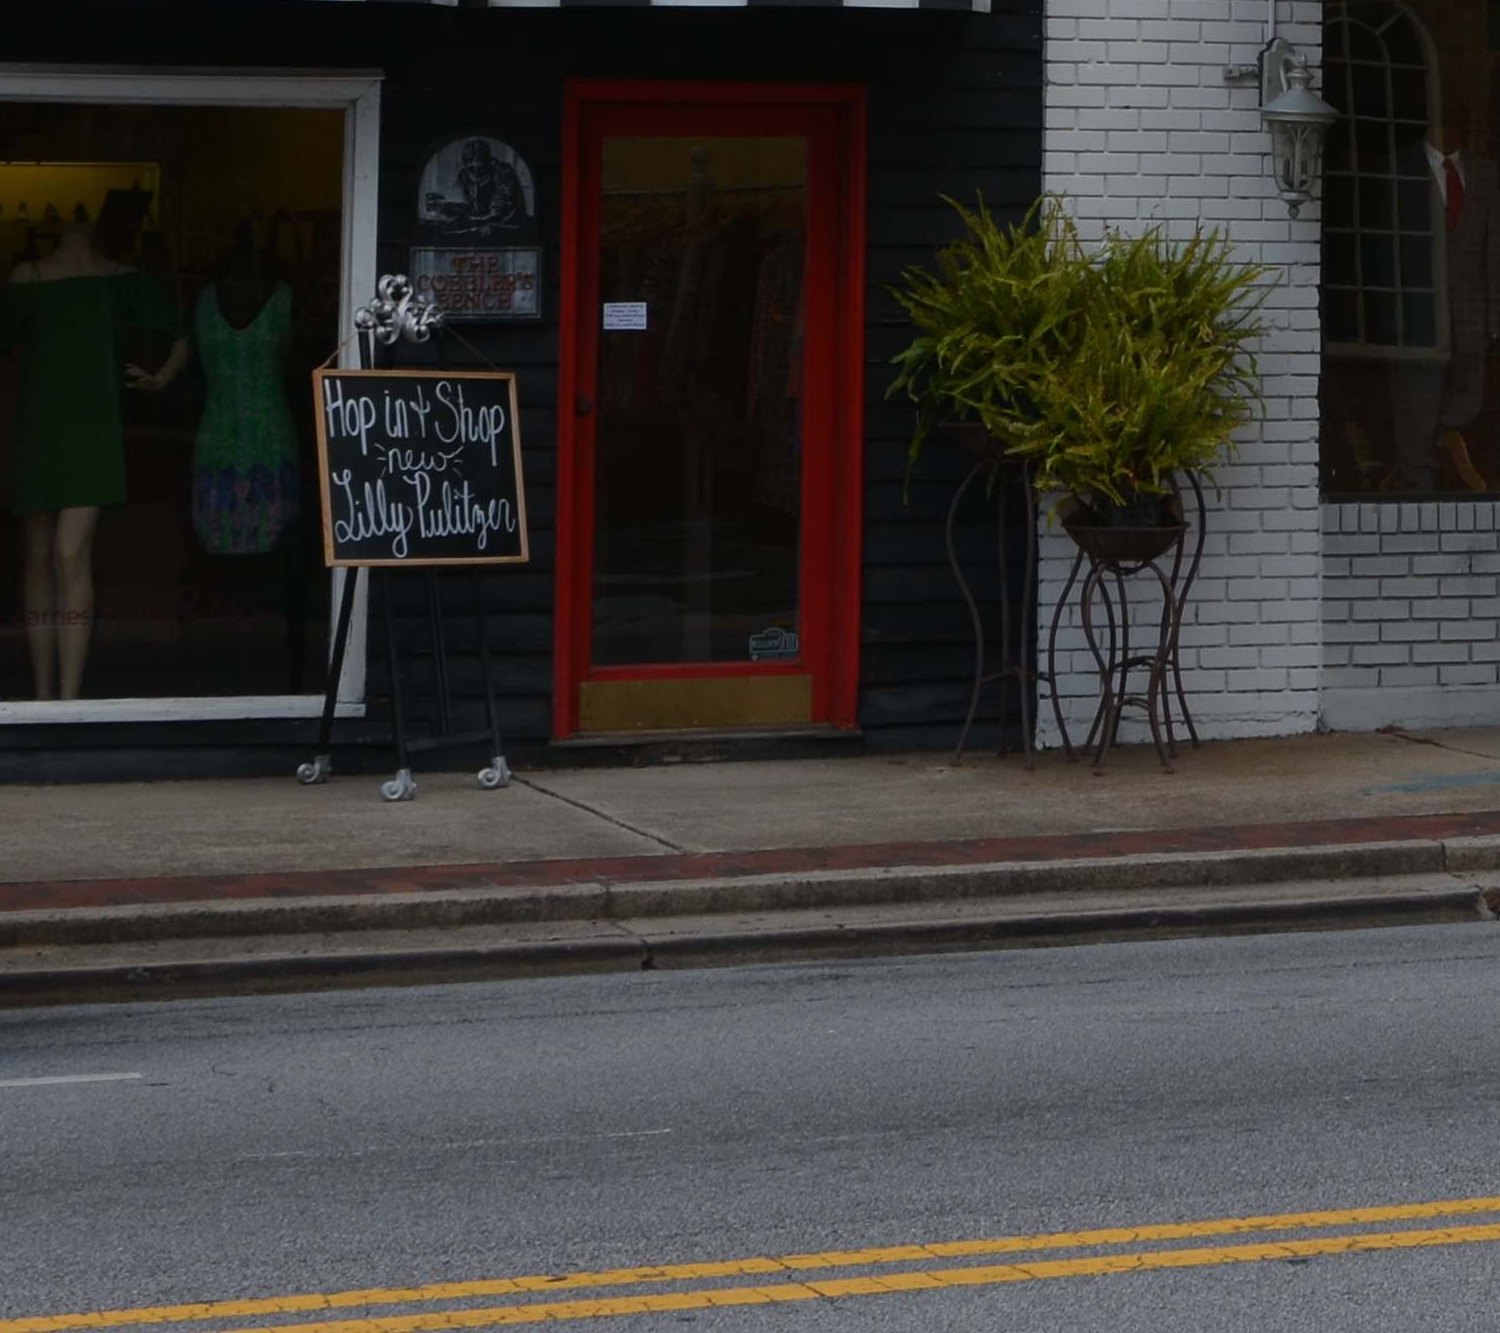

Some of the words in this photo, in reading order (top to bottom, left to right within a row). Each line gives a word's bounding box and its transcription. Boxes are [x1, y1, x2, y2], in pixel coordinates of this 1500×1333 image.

[451, 255, 499, 273] THE
[417, 272, 533, 292] COBBLER'S
[437, 292, 512, 310] BENCH
[323, 378, 377, 456] Hop
[434, 380, 506, 467] Shop
[388, 448, 458, 474] new
[331, 468, 414, 559] Lilly
[402, 470, 517, 551] Pulitzer
[12, 606, 92, 627] carries
